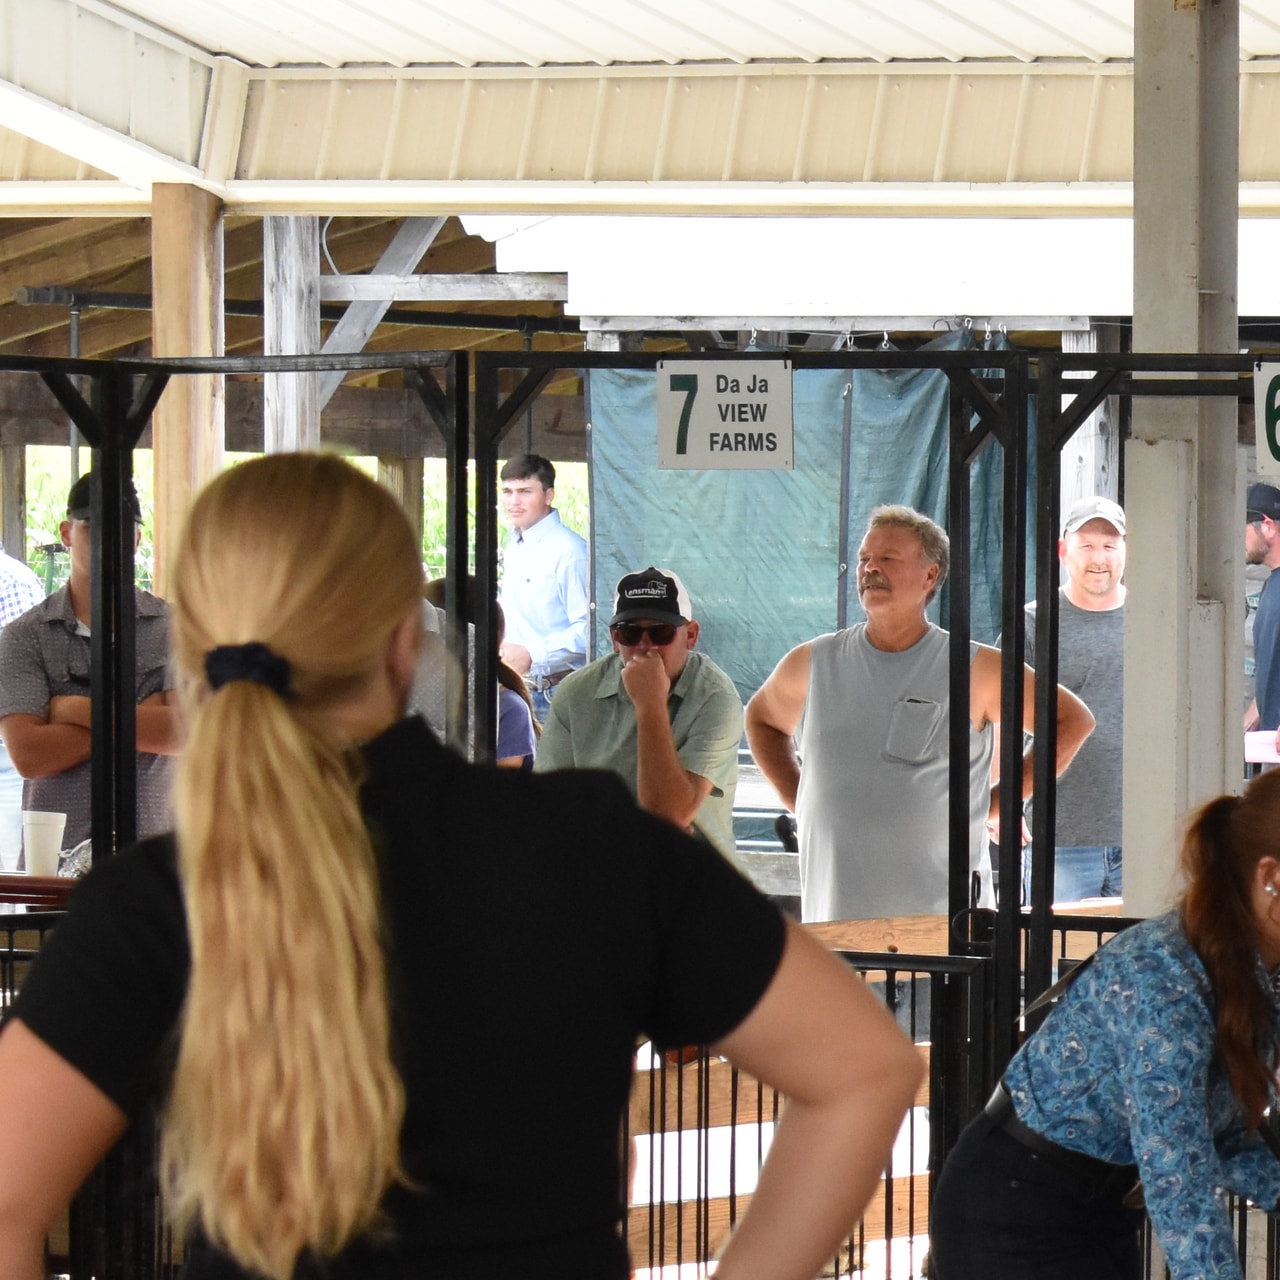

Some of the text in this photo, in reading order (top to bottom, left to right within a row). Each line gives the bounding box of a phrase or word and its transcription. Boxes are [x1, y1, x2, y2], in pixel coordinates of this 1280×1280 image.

[716, 374, 769, 393] Da Ja
[669, 374, 698, 455] 7
[717, 403, 768, 422] VIEW
[709, 432, 777, 452] FARMS
